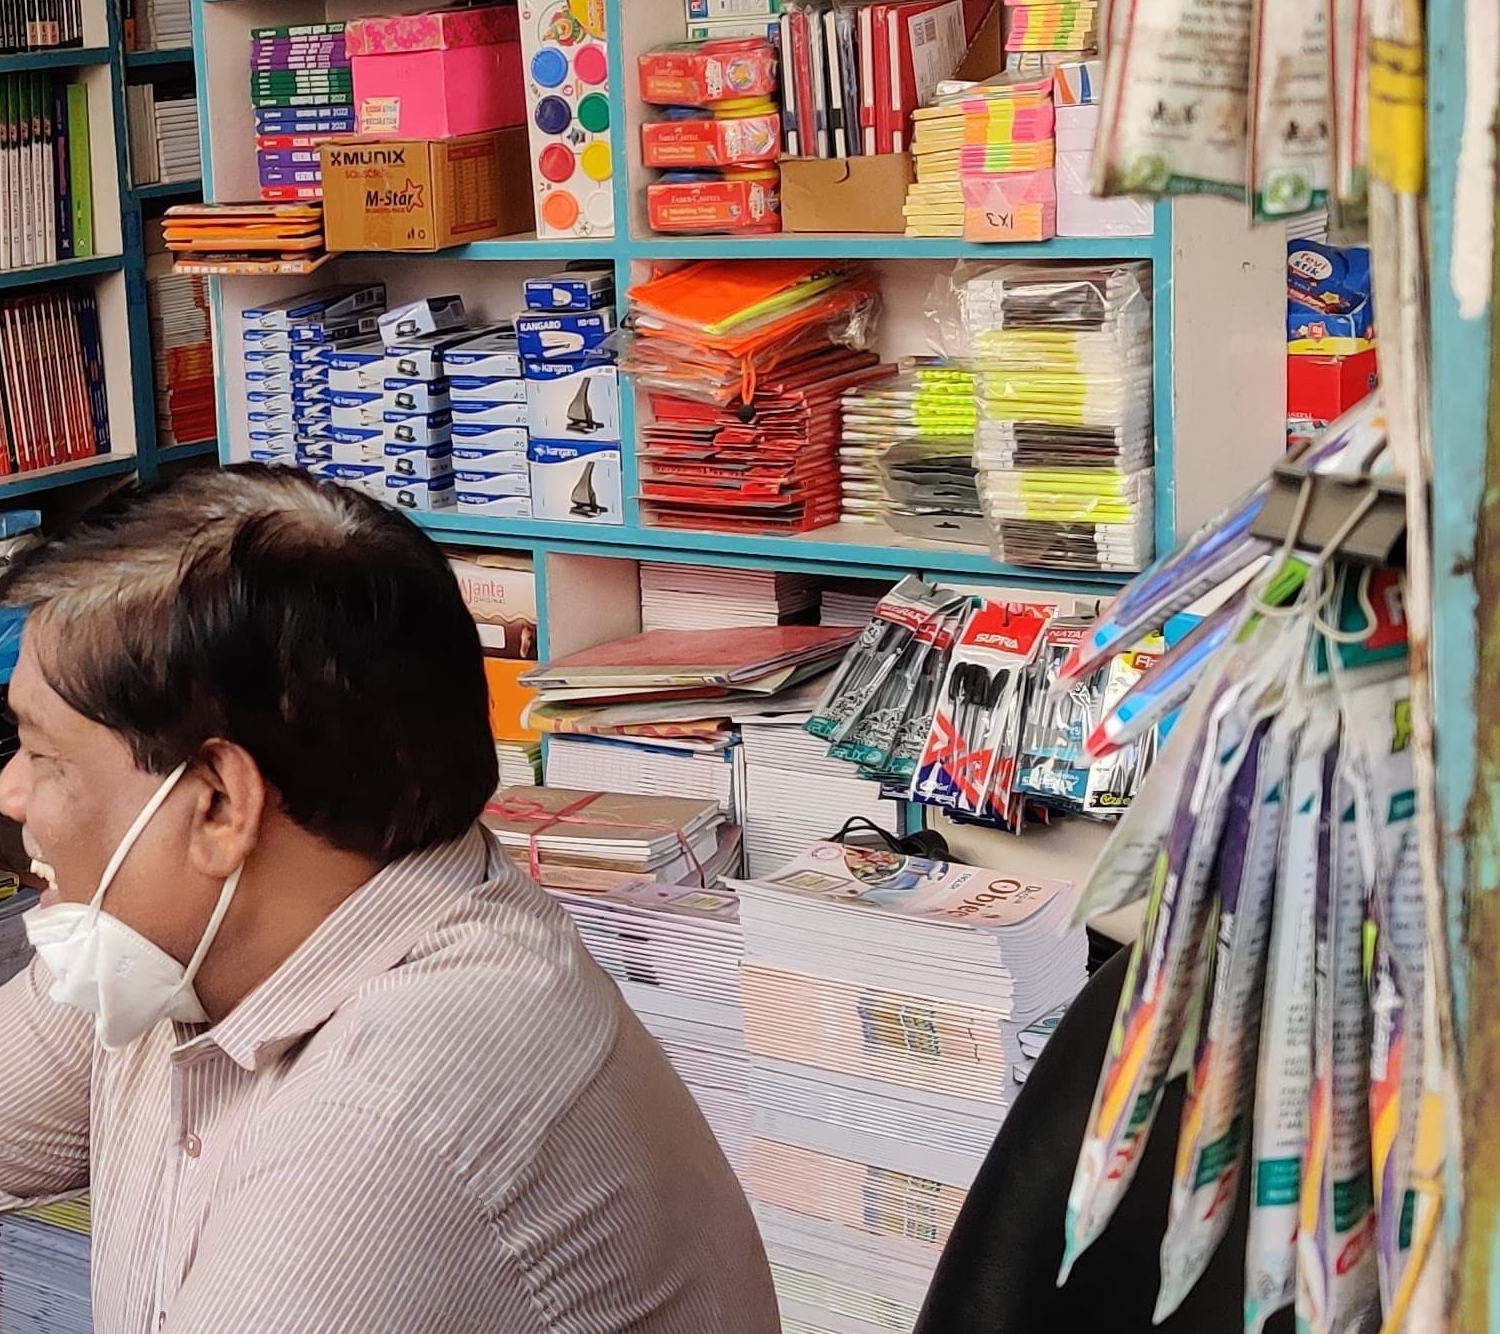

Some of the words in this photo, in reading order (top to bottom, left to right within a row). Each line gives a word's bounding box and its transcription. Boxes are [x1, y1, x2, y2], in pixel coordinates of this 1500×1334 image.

[330, 150, 405, 167] XMUNIX
[365, 189, 414, 207] M-Star
[1293, 260, 1320, 277] stik
[520, 320, 561, 331] KANGARO
[541, 363, 573, 373] kangaro
[546, 447, 578, 457] kangaro
[974, 632, 1019, 650] SUPRA
